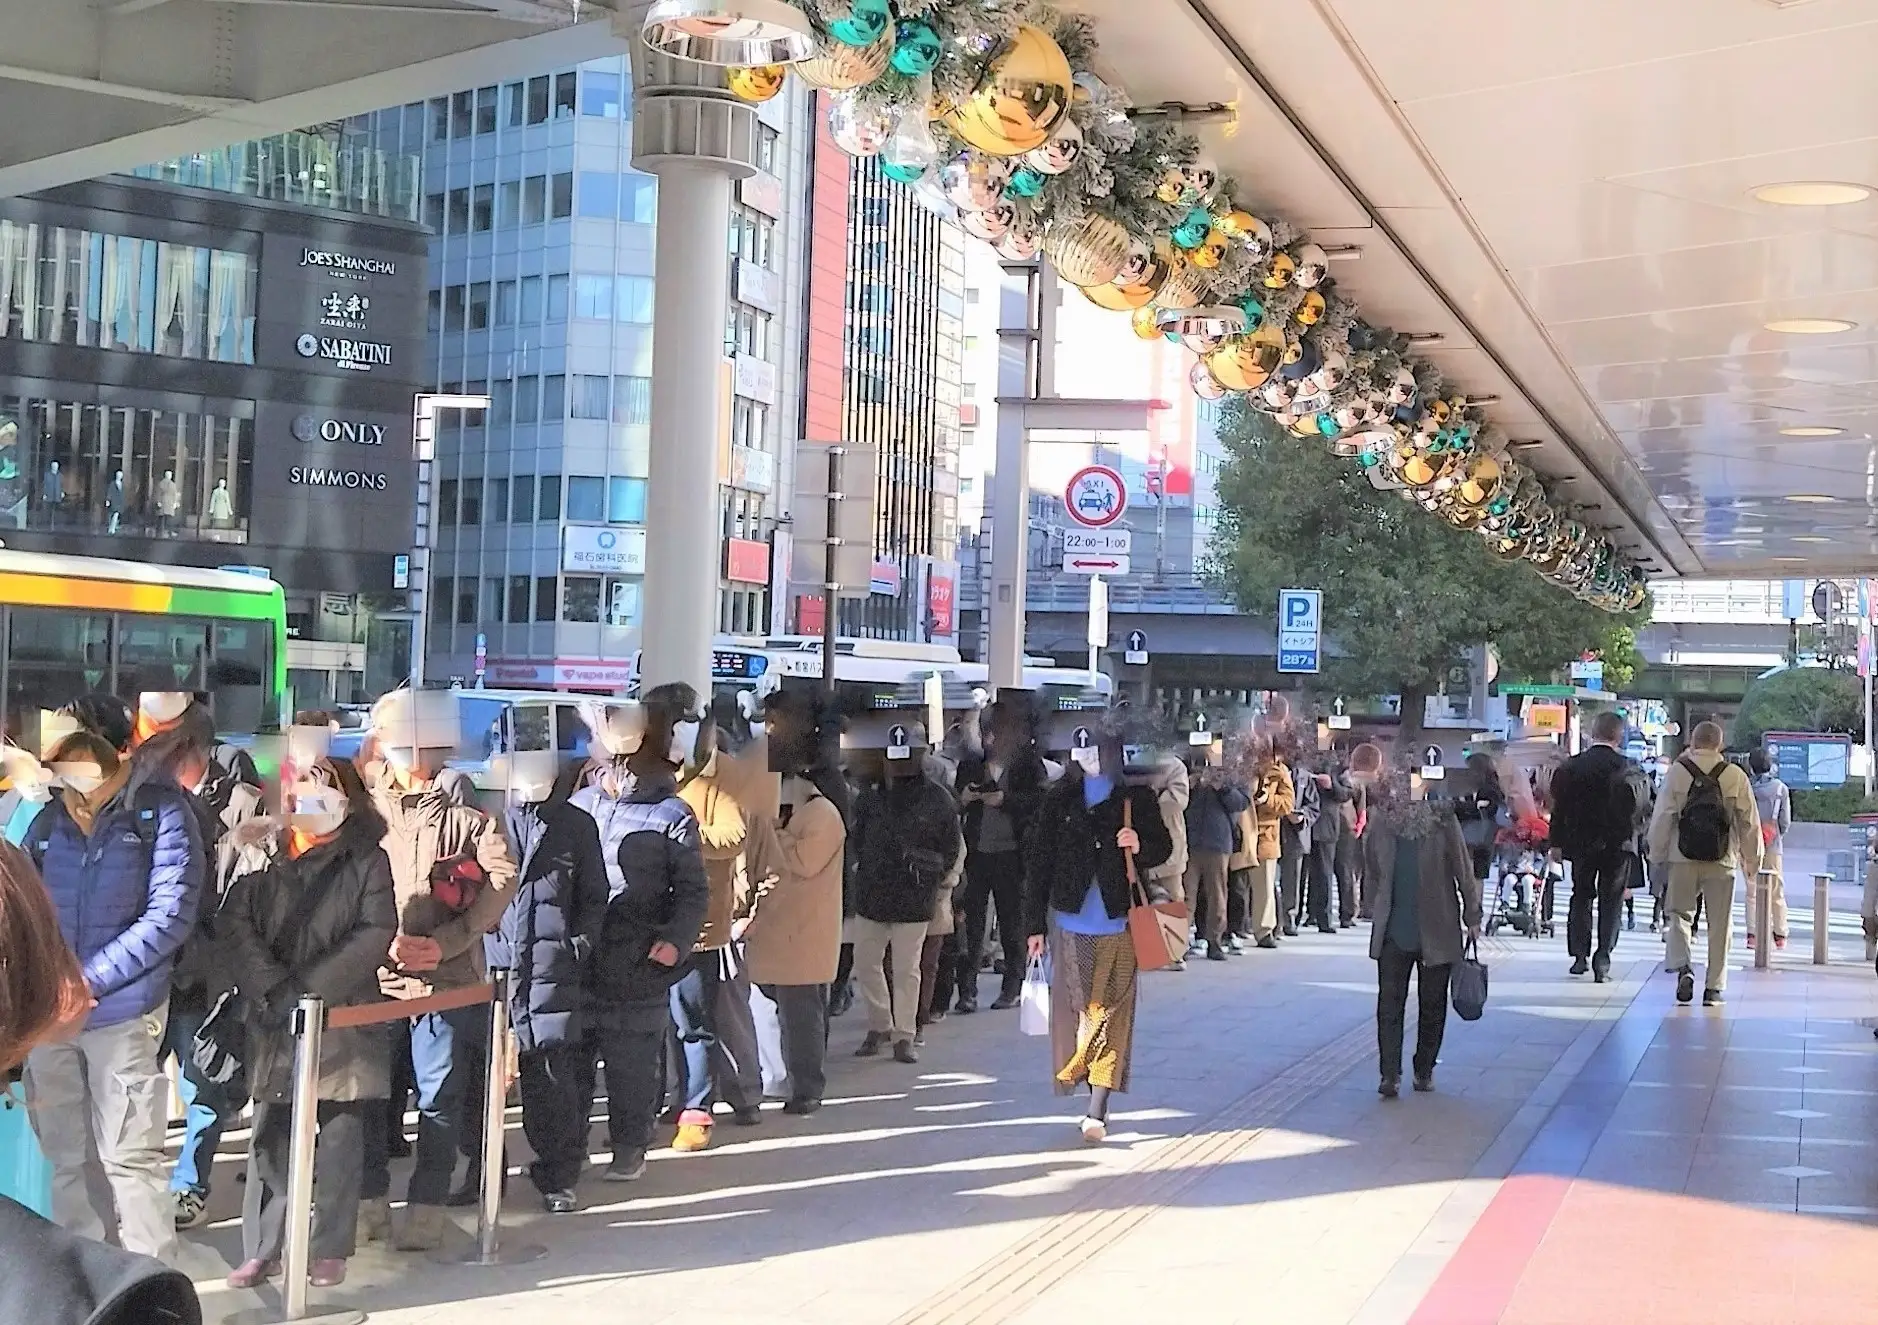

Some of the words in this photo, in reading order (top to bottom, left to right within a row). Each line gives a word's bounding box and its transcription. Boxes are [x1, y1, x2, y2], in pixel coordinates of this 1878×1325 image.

[300, 247, 332, 267] JOE'S
[333, 253, 395, 275] SHANGHAI
[320, 337, 391, 365] SABATINI
[320, 419, 388, 445] ONLY
[290, 466, 387, 490] SIMMONS
[1067, 534, 1126, 548] 22:00-1:00
[1287, 597, 1311, 627] P
[1295, 620, 1313, 628] 24H
[1284, 637, 1315, 647] イトシア
